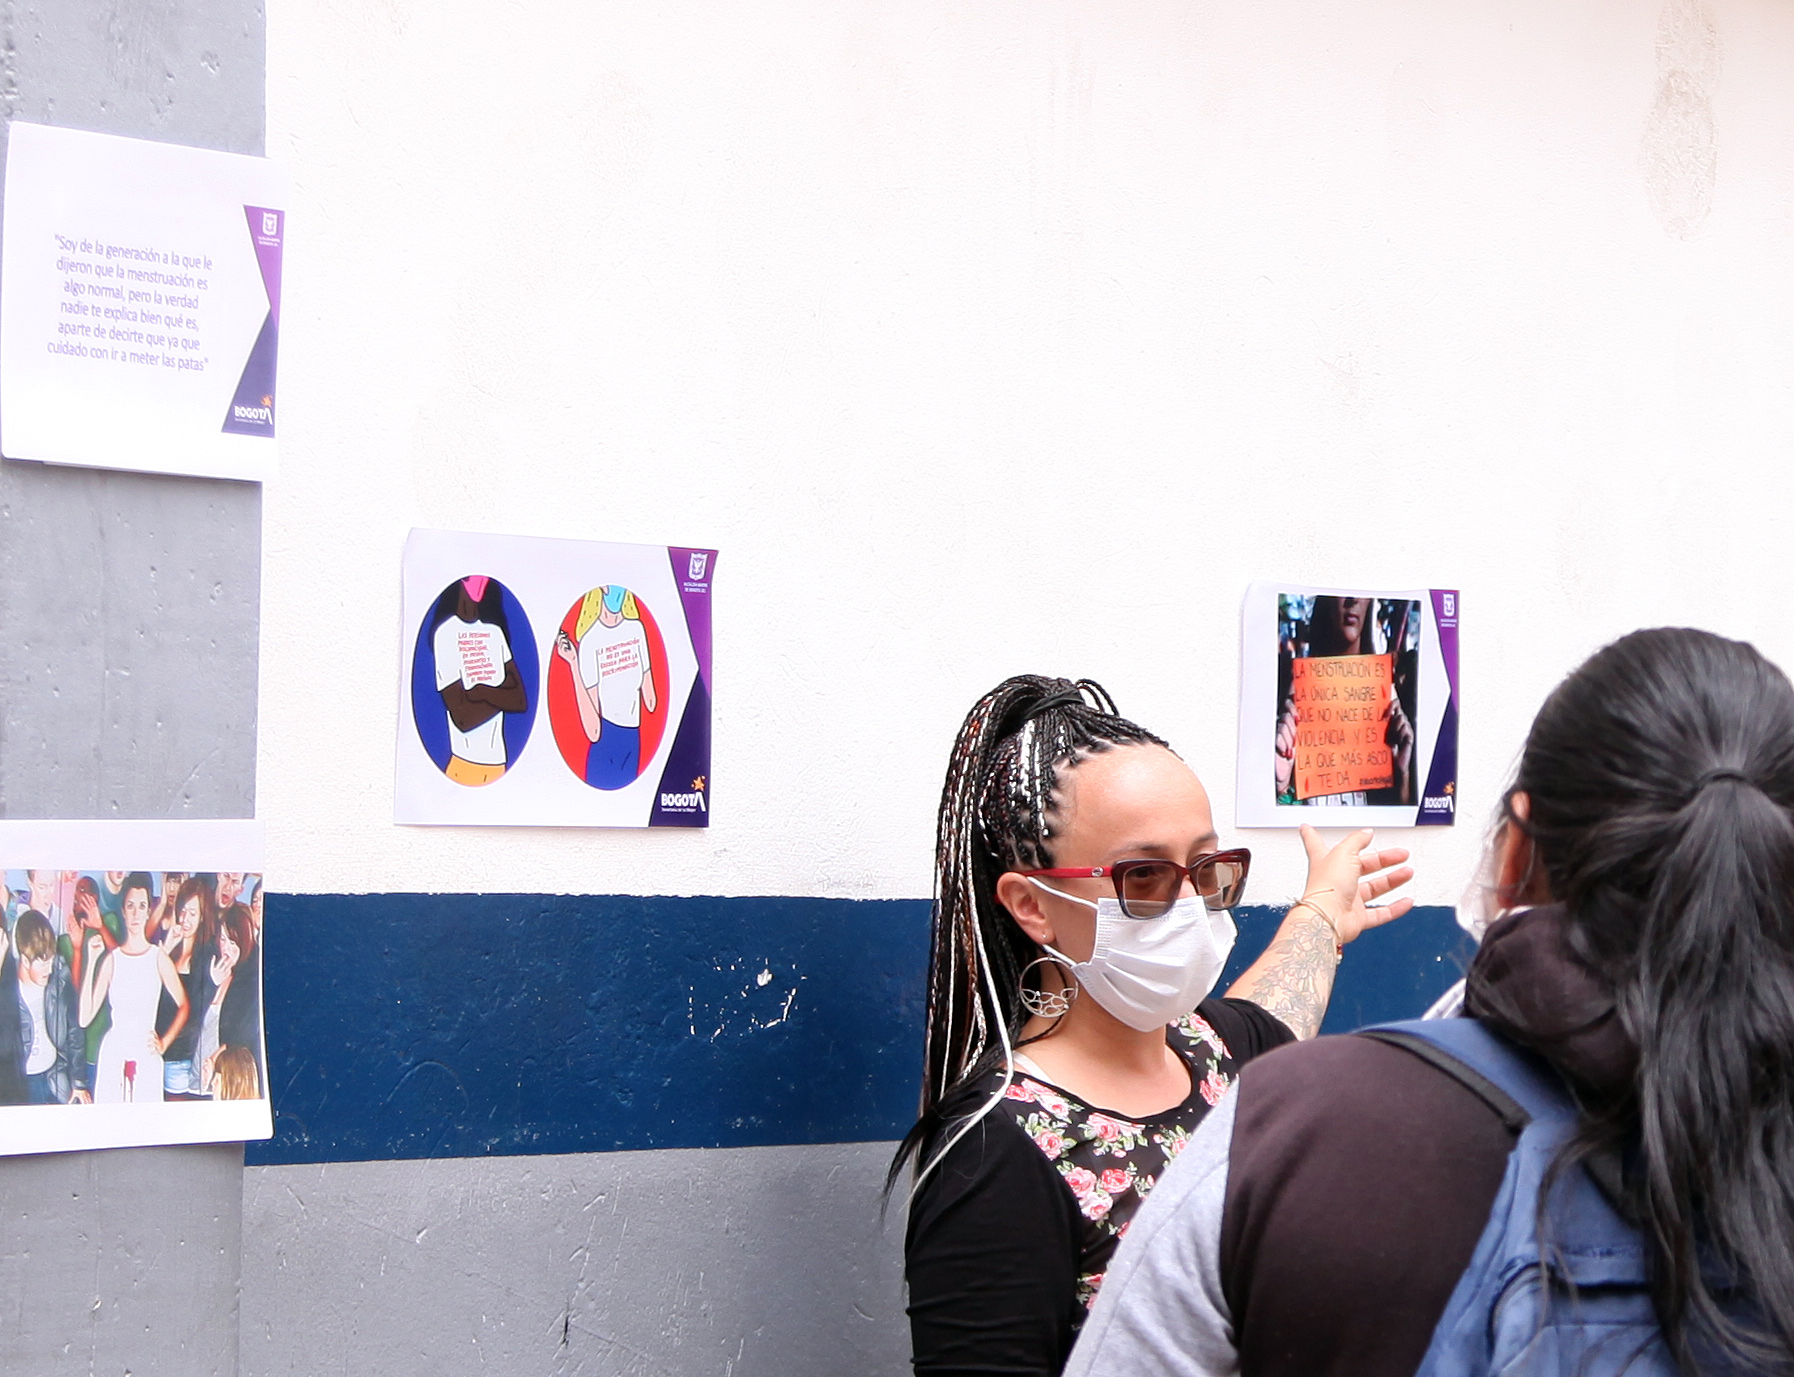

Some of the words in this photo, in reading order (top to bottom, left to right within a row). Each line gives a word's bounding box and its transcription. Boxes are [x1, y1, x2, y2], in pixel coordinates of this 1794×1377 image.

[80, 239, 93, 253] de
[95, 240, 103, 255] la
[106, 245, 160, 263] generación
[163, 253, 168, 264] a
[172, 251, 179, 265] la
[182, 256, 201, 269] que
[204, 255, 212, 270] le
[57, 257, 92, 274] dijeron
[95, 264, 113, 278] que
[116, 264, 125, 279] la
[127, 268, 194, 288] menstruación
[197, 278, 208, 290] es
[64, 279, 85, 296] algo
[88, 283, 126, 302] normal,
[129, 290, 151, 303] pero
[154, 290, 162, 304] la
[165, 294, 199, 309] verdad
[61, 301, 89, 316] nadie
[91, 304, 101, 317] te
[104, 306, 137, 322] explica
[140, 309, 162, 325] bien
[165, 314, 183, 330] qué
[186, 318, 199, 332] es,
[58, 322, 91, 336] aparte
[94, 324, 106, 339] de
[109, 326, 144, 343] decirte
[146, 333, 165, 347] que
[168, 336, 178, 350] ya
[181, 338, 200, 351] que
[47, 341, 88, 357] cuidado
[90, 347, 108, 359] con
[111, 347, 119, 360] ir
[121, 351, 126, 362] a
[130, 352, 160, 366] meter
[162, 353, 175, 368] las
[1295, 662, 1305, 678] LA
[1310, 660, 1371, 678] MENSTRUACIÓN
[1375, 663, 1384, 678] ES
[1296, 687, 1306, 702] LA
[1310, 685, 1339, 701] ÚNICA
[1344, 686, 1376, 702] SANGRE
[1297, 707, 1313, 723] QUE
[1318, 708, 1331, 722] NO
[1337, 708, 1358, 722] NACE
[1363, 707, 1373, 721] DE
[1297, 729, 1345, 747] VIOLENCIA
[1354, 729, 1360, 745] Y
[1366, 727, 1377, 743] ES
[1298, 754, 1311, 770] LA
[1317, 752, 1335, 768] QUE
[1341, 749, 1362, 765] MÁS
[1367, 749, 1388, 765] ASCO
[1318, 773, 1332, 788] TE
[1337, 770, 1350, 786] DA
